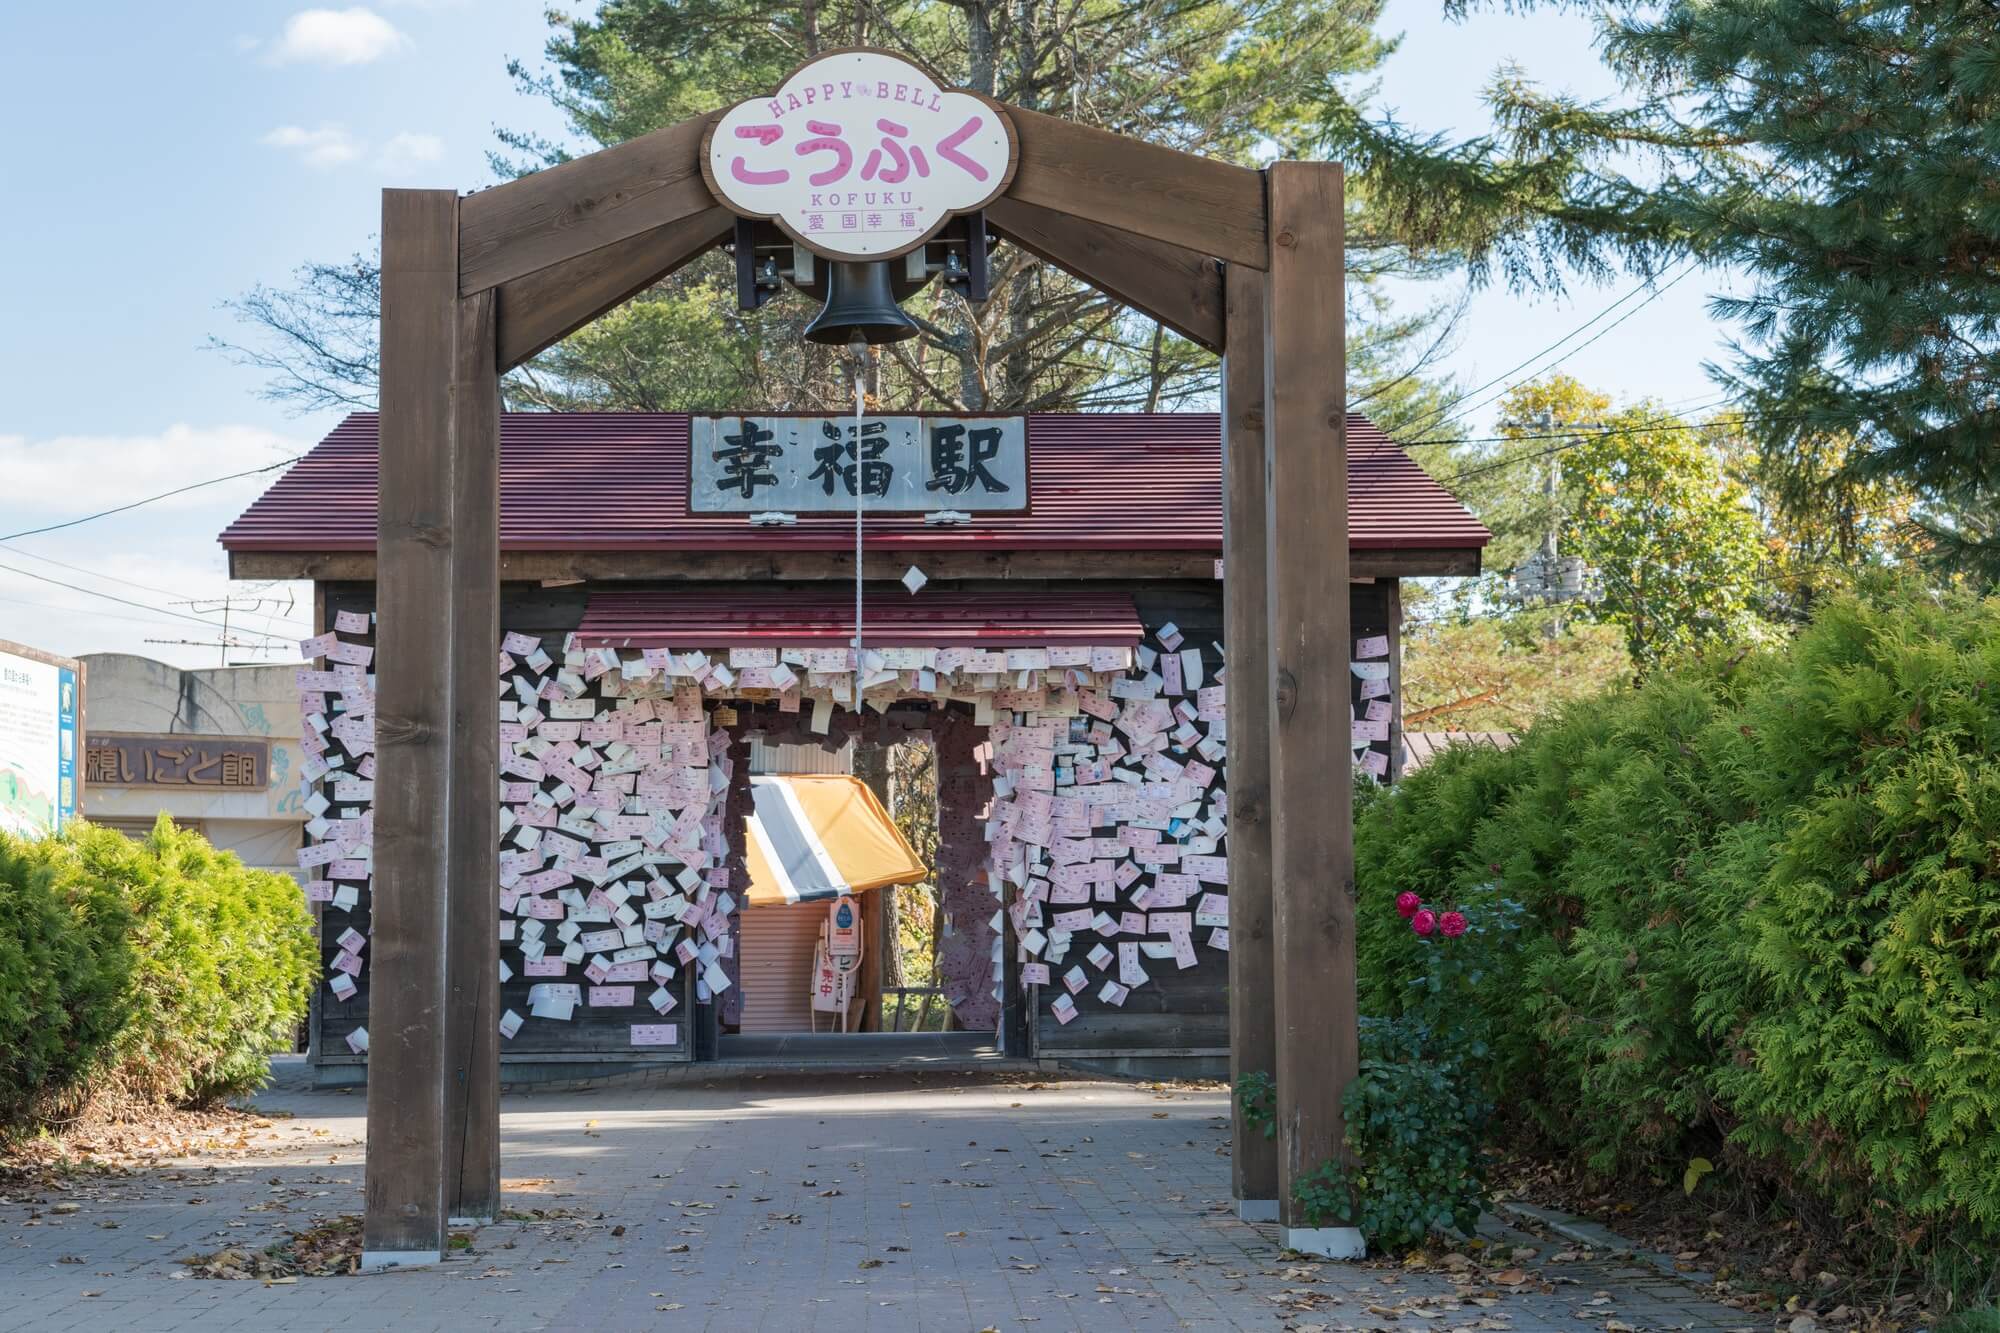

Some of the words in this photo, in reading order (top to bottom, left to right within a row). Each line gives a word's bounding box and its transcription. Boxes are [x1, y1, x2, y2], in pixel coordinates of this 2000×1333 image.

[767, 81, 852, 119] HAPPY
[876, 81, 942, 113] BELL
[731, 116, 989, 187] こうふく
[811, 191, 912, 207] KOFUKU
[712, 420, 1010, 499] 幸福駅
